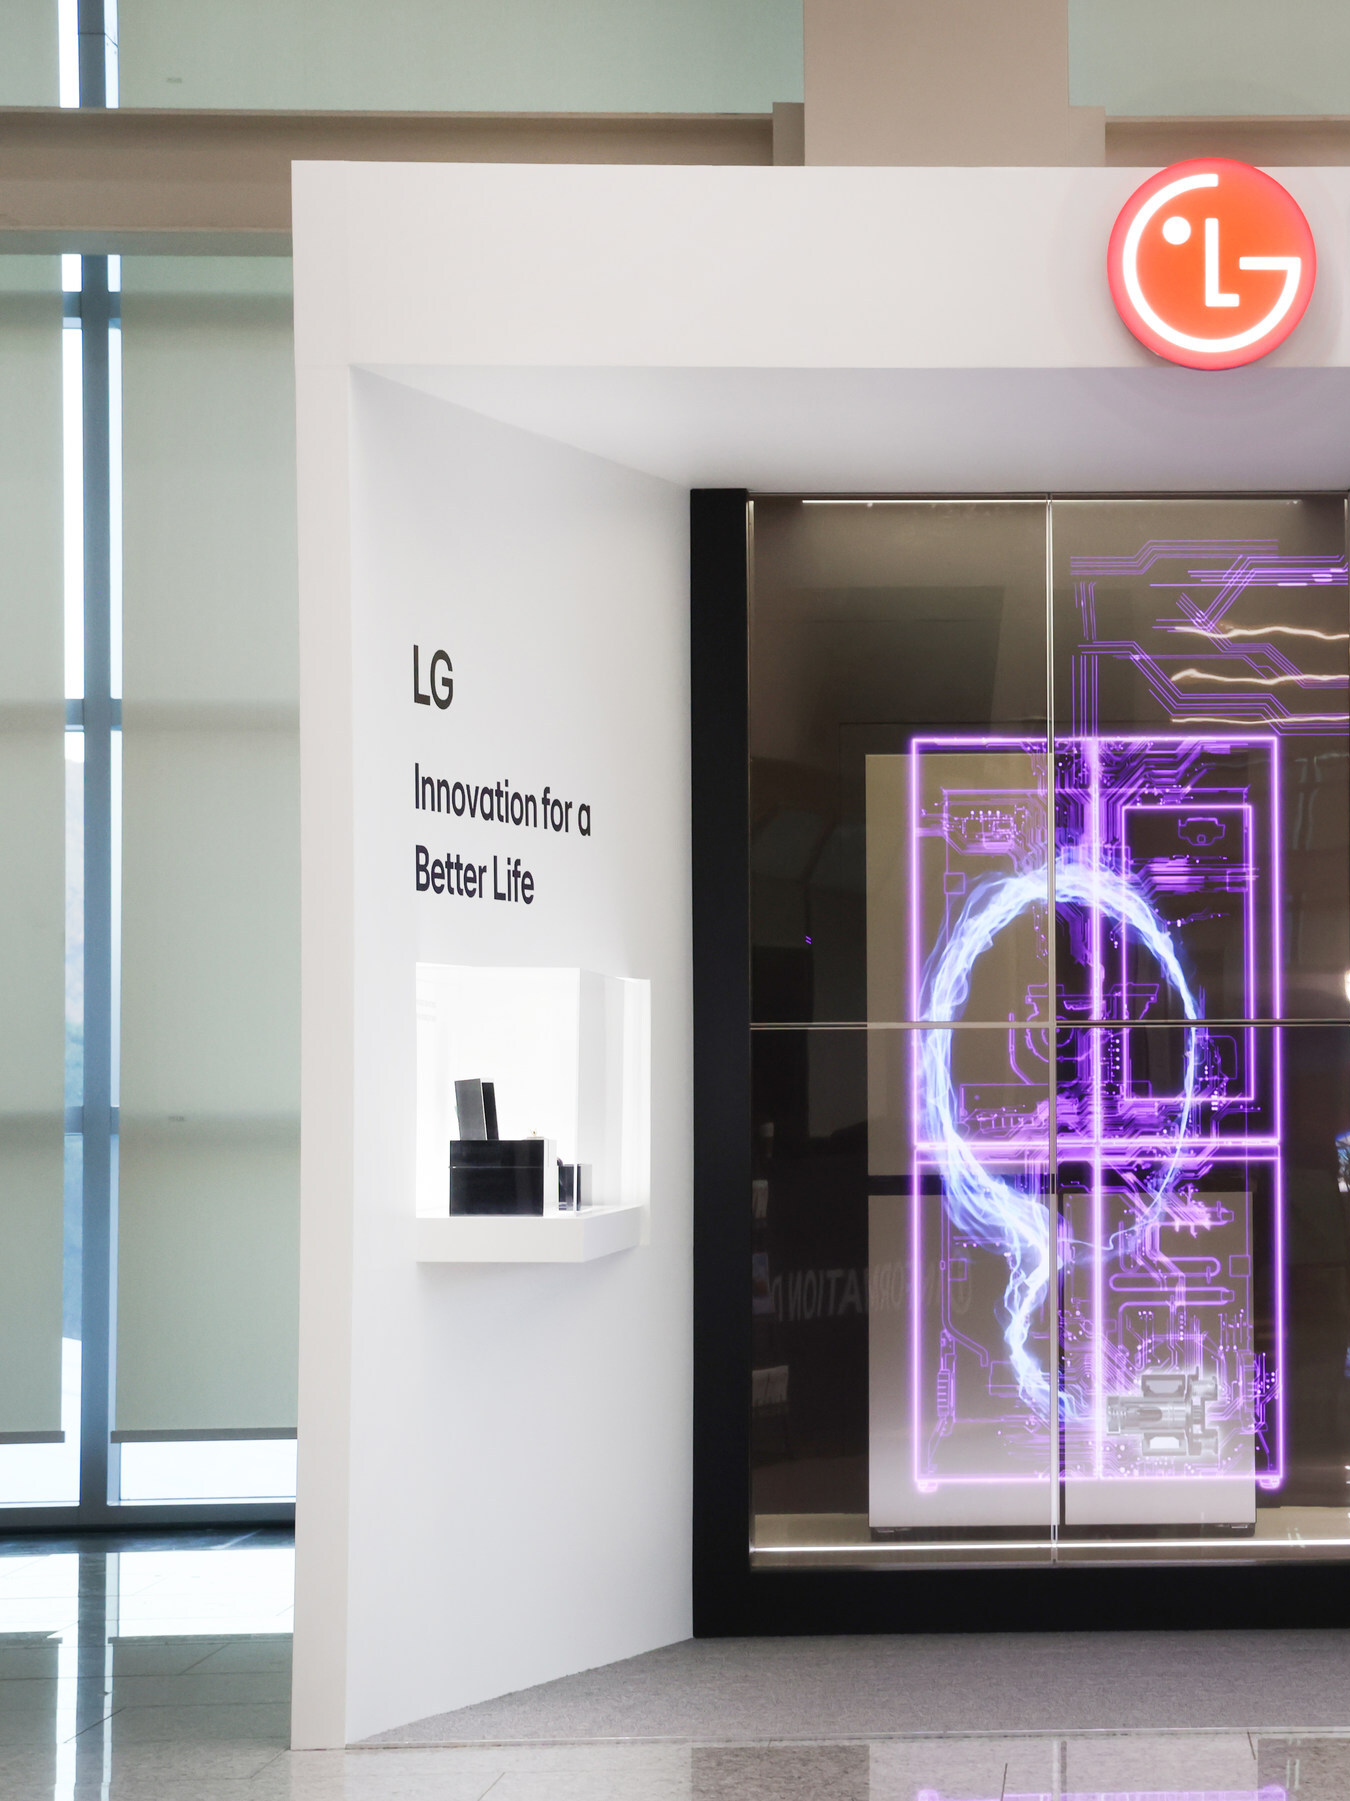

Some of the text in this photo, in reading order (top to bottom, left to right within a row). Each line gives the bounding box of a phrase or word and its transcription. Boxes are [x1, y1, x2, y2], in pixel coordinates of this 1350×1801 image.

[413, 644, 454, 710] LG
[415, 762, 591, 836] Innovation for a
[415, 844, 535, 905] Better Life
